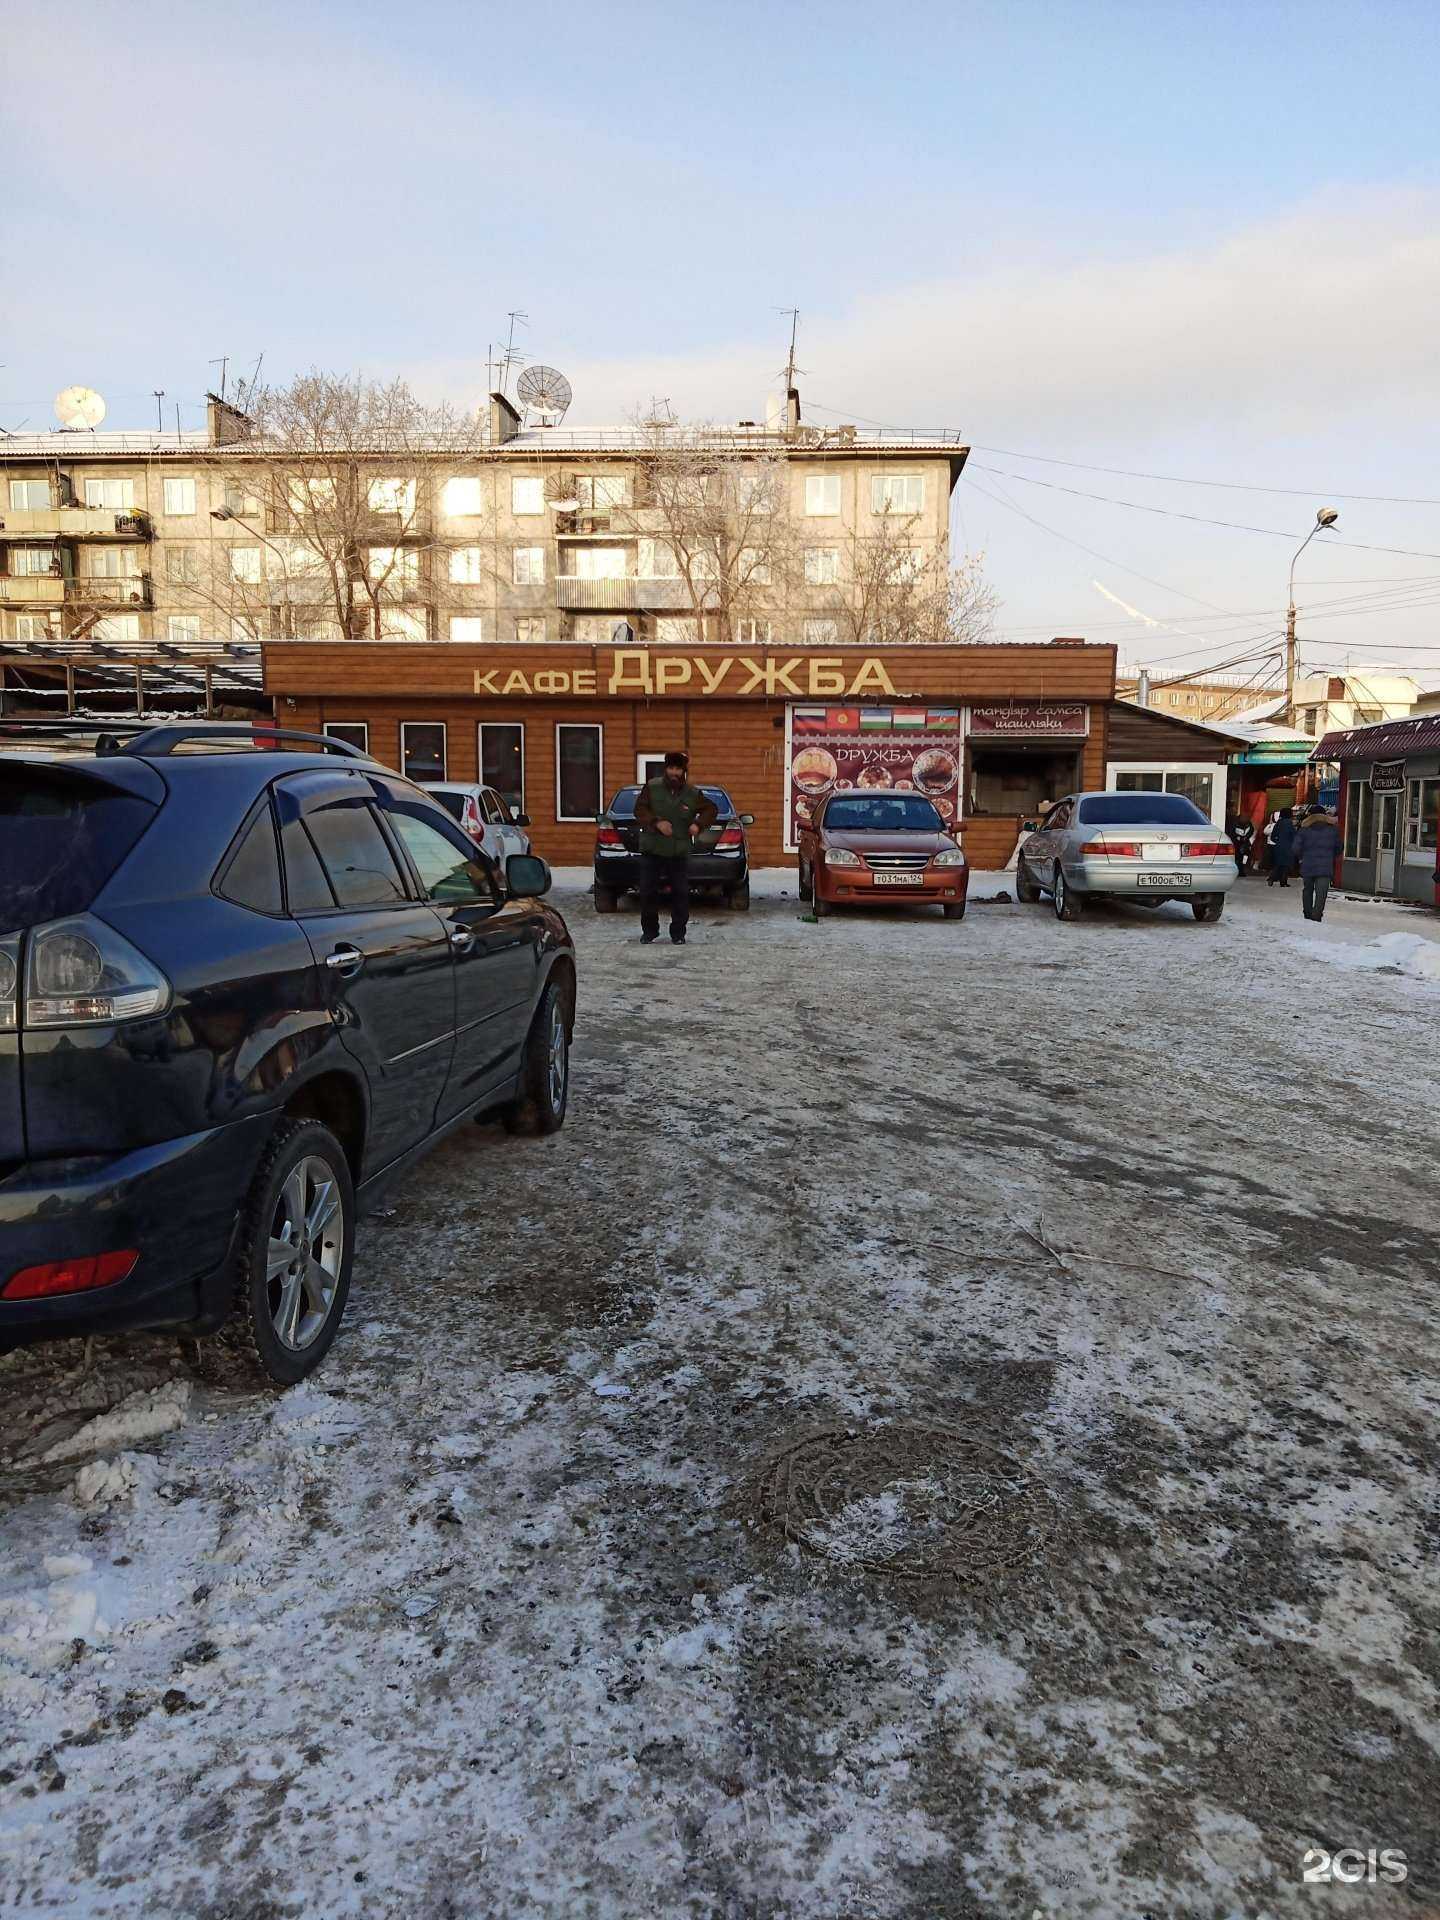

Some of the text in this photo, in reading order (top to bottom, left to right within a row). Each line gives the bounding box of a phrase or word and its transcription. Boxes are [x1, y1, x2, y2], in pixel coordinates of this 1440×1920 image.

[473, 650, 897, 695] КАФЕ ДРУЖБА
[1036, 704, 1082, 716] самса
[995, 715, 1063, 729] шашлыки
